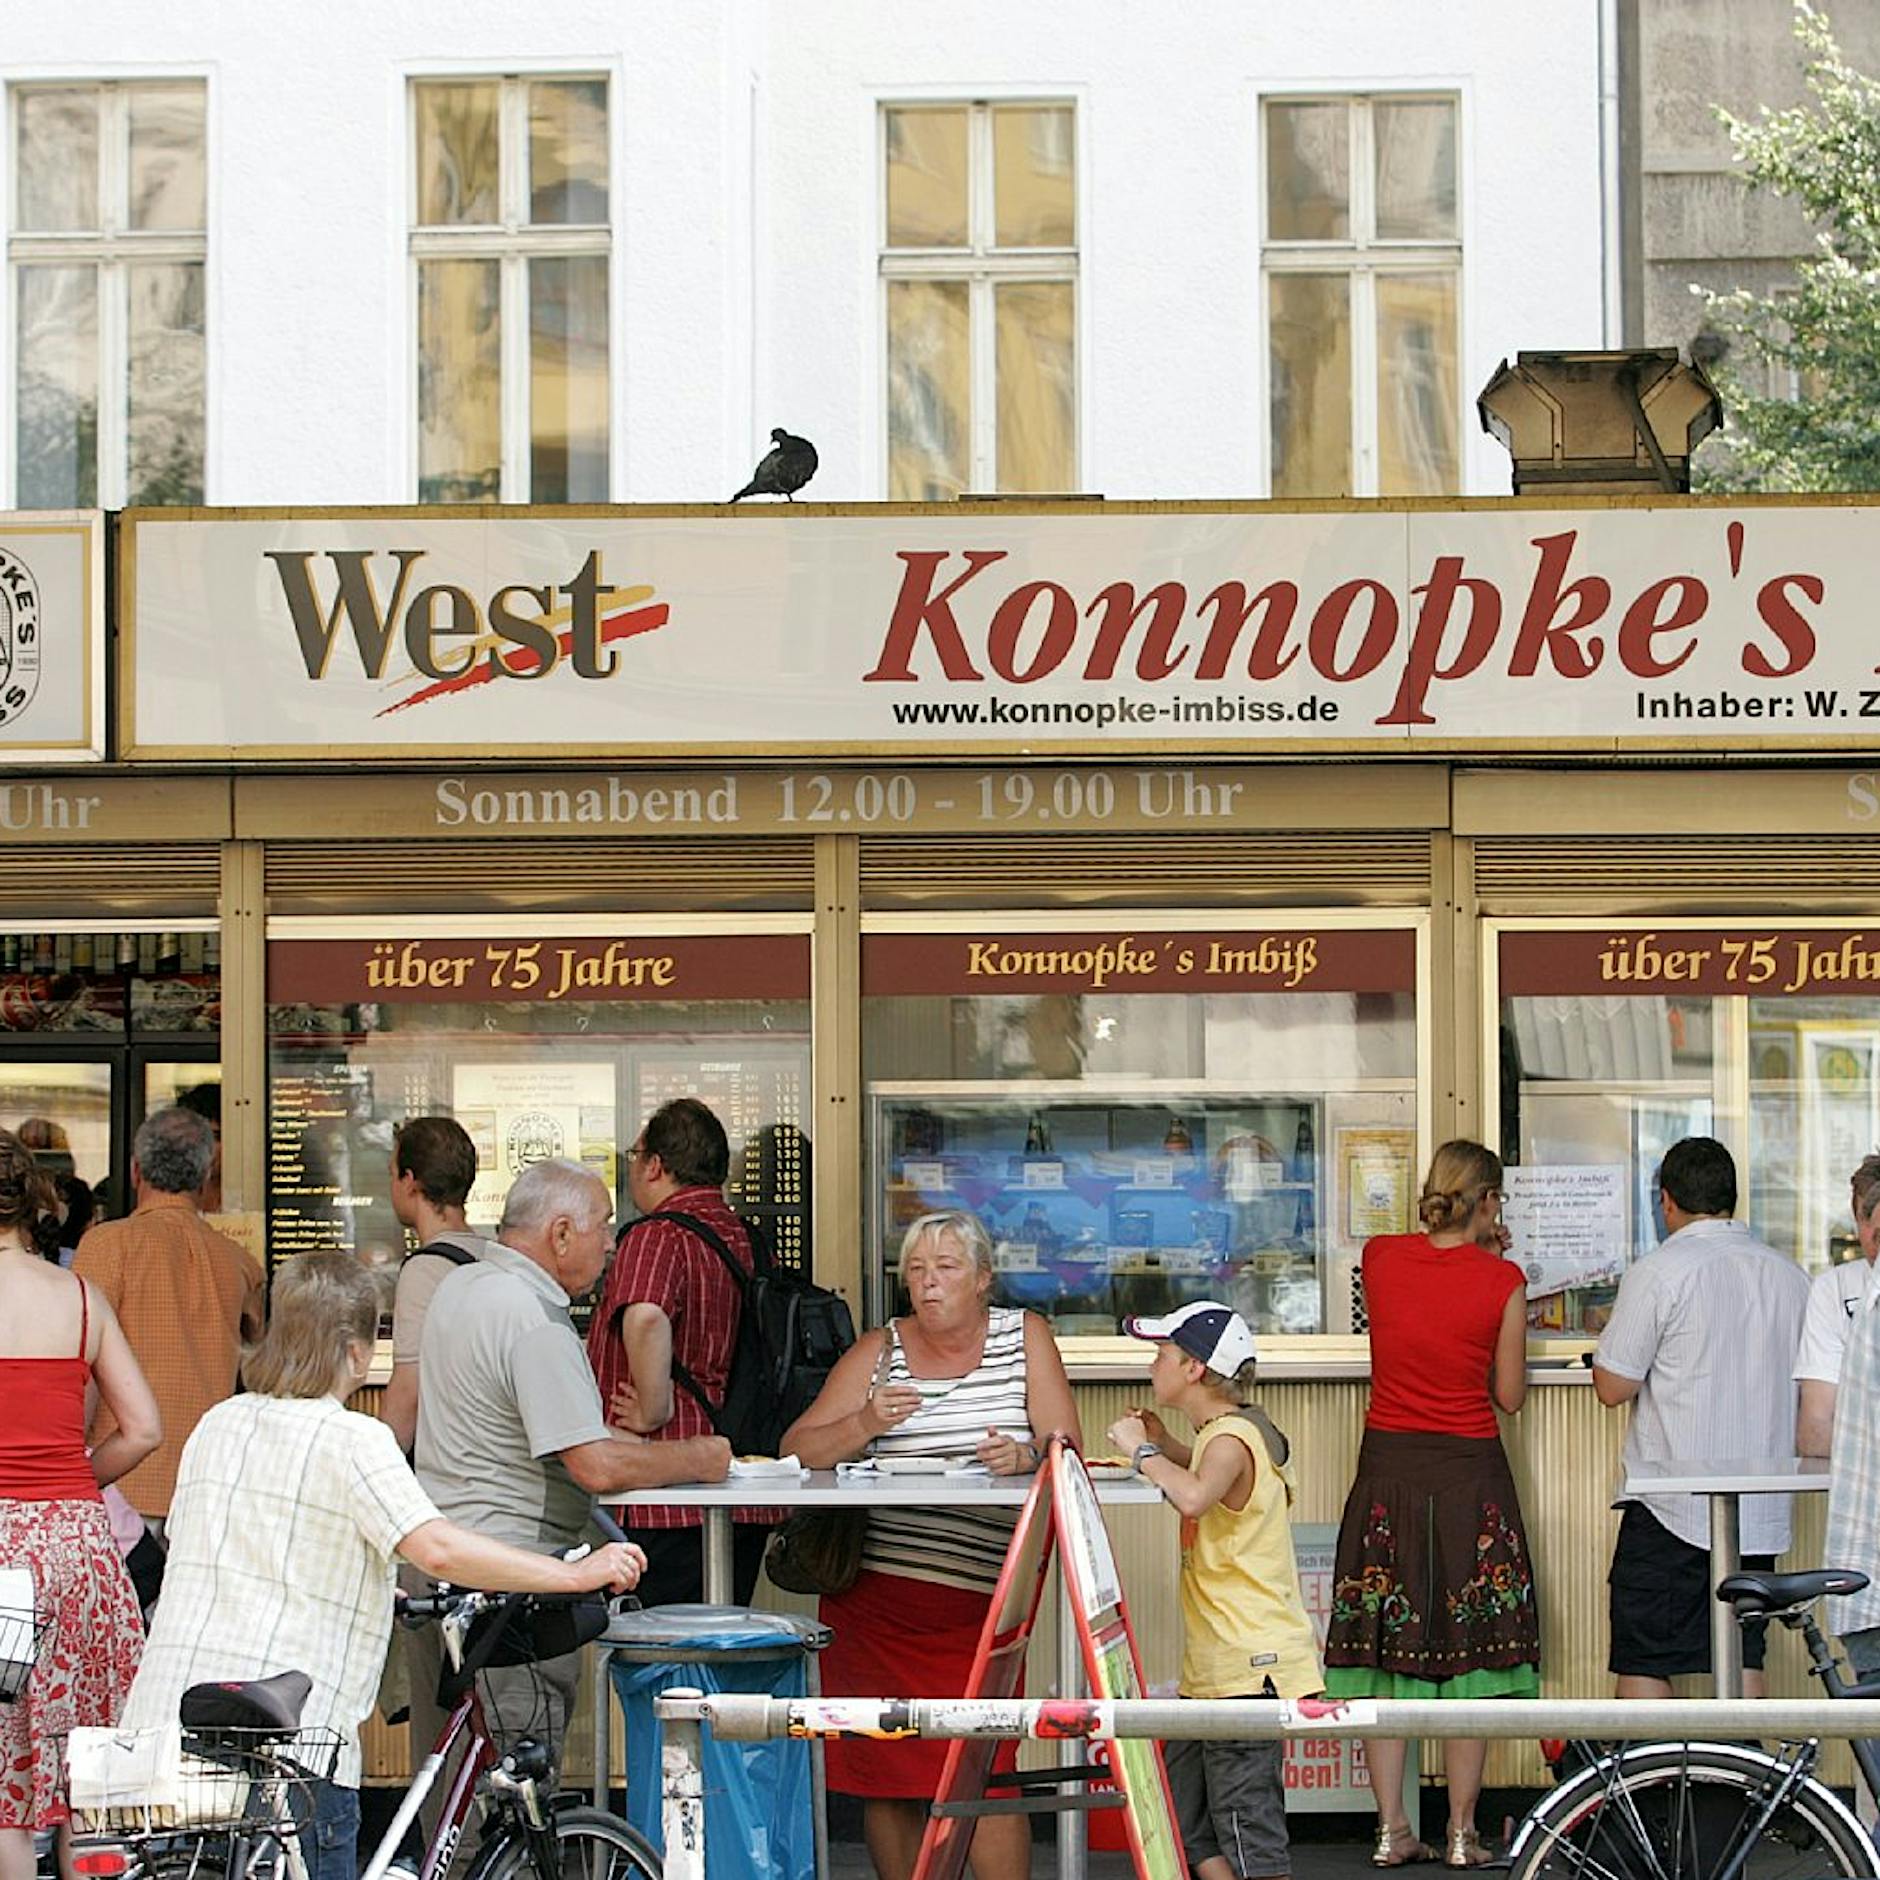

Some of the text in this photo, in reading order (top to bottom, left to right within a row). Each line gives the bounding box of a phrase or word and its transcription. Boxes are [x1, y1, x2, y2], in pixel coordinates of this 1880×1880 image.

[264, 549, 619, 681] West
[863, 521, 1824, 725] Konnopke's
[894, 696, 1338, 728] www.konnopke-imbiss.de
[1637, 691, 1794, 717] Inhaber:
[1804, 690, 1848, 717] W.
[1, 784, 101, 831] Uhr
[435, 777, 737, 826] Sonnabend
[777, 774, 915, 822] 12.00
[976, 771, 1114, 819] 19.00
[1134, 770, 1242, 817] Uhr
[366, 941, 676, 1000] über 75 Jahre
[1205, 937, 1318, 987] Imbiß
[1599, 935, 1709, 981] über
[1720, 936, 1777, 979] 75
